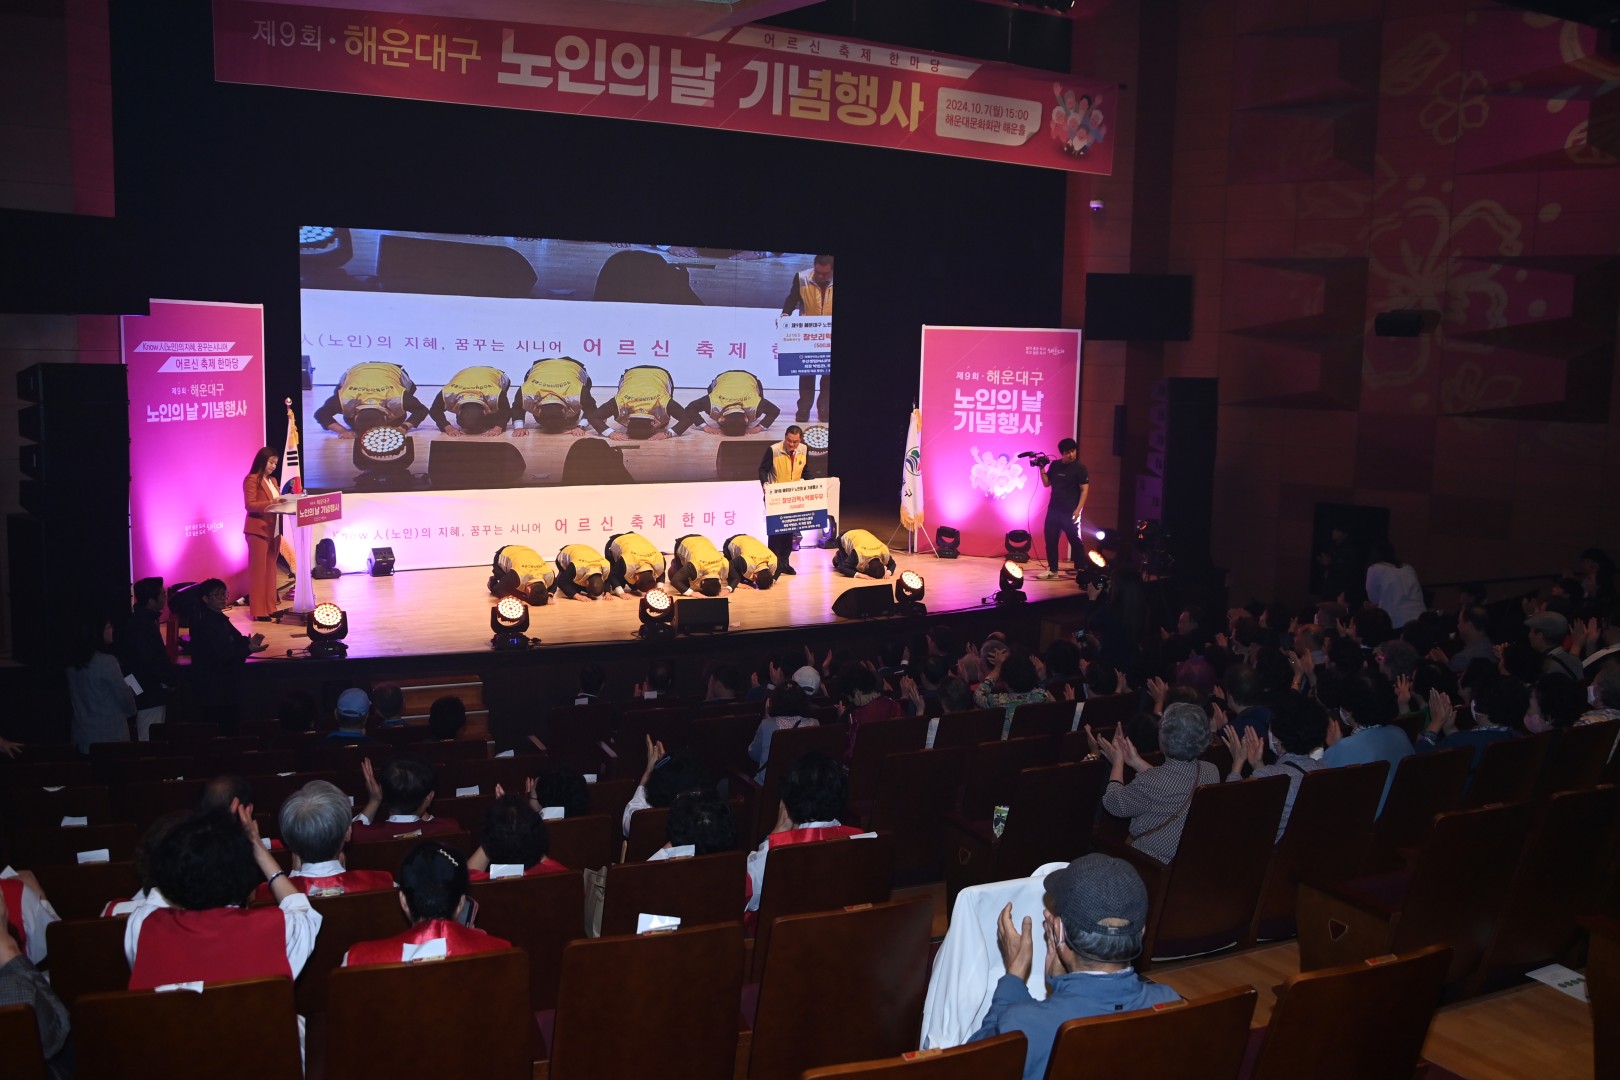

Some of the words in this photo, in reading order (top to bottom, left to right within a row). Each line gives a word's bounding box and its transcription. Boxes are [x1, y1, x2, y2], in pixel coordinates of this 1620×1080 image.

[764, 33, 820, 54] 어르신
[839, 43, 871, 62] 축제
[889, 52, 940, 72] 한마당
[344, 24, 481, 74] 해운대구
[498, 28, 660, 101] 노인의
[670, 48, 722, 107] 날
[739, 60, 924, 132] 기념행사
[945, 99, 1004, 118] 2024.10.7(월)
[1005, 108, 1029, 120] 15:00
[945, 113, 1001, 132] 해운대문화회관
[142, 342, 158, 350] Know
[455, 338, 505, 351] 꿈꾸는
[516, 340, 562, 353] 시니어
[583, 338, 670, 357] 어르신
[695, 340, 747, 359] 축제
[175, 358, 198, 370] 어르신
[201, 358, 215, 370] 축제
[218, 357, 239, 370] 한마당
[986, 370, 1044, 386] 해운대구
[190, 383, 224, 397] 해운대구
[954, 388, 1018, 411] 노인의
[1021, 390, 1044, 413] 날
[146, 403, 184, 422] 노인의
[186, 402, 199, 421] 날
[201, 399, 247, 419] 기념행사
[953, 411, 1043, 436] 기념행사
[471, 525, 503, 536] 꿈꾸는
[510, 523, 541, 534] 시니어
[555, 515, 614, 534] 어르신
[630, 514, 666, 530] 축제
[682, 511, 736, 527] 한마당
